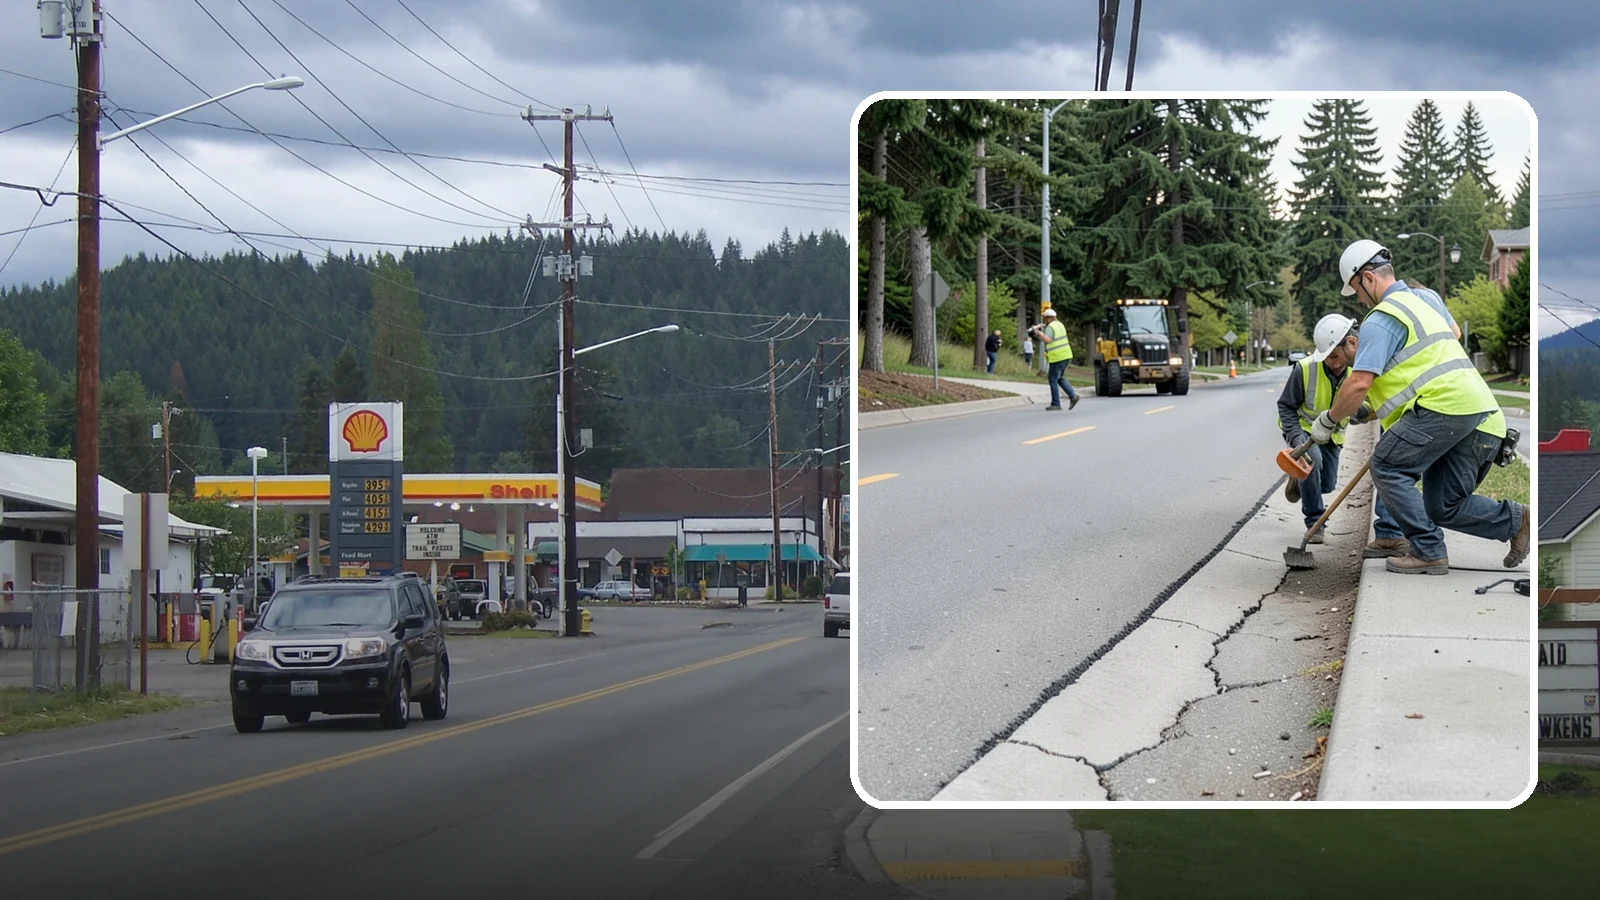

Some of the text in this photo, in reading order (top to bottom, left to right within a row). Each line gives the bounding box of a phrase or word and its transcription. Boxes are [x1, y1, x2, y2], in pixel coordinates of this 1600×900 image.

[366, 480, 383, 490] 395
[490, 484, 547, 499] Shell
[366, 494, 383, 504] 405
[366, 508, 383, 518] 415
[366, 522, 383, 532] 429
